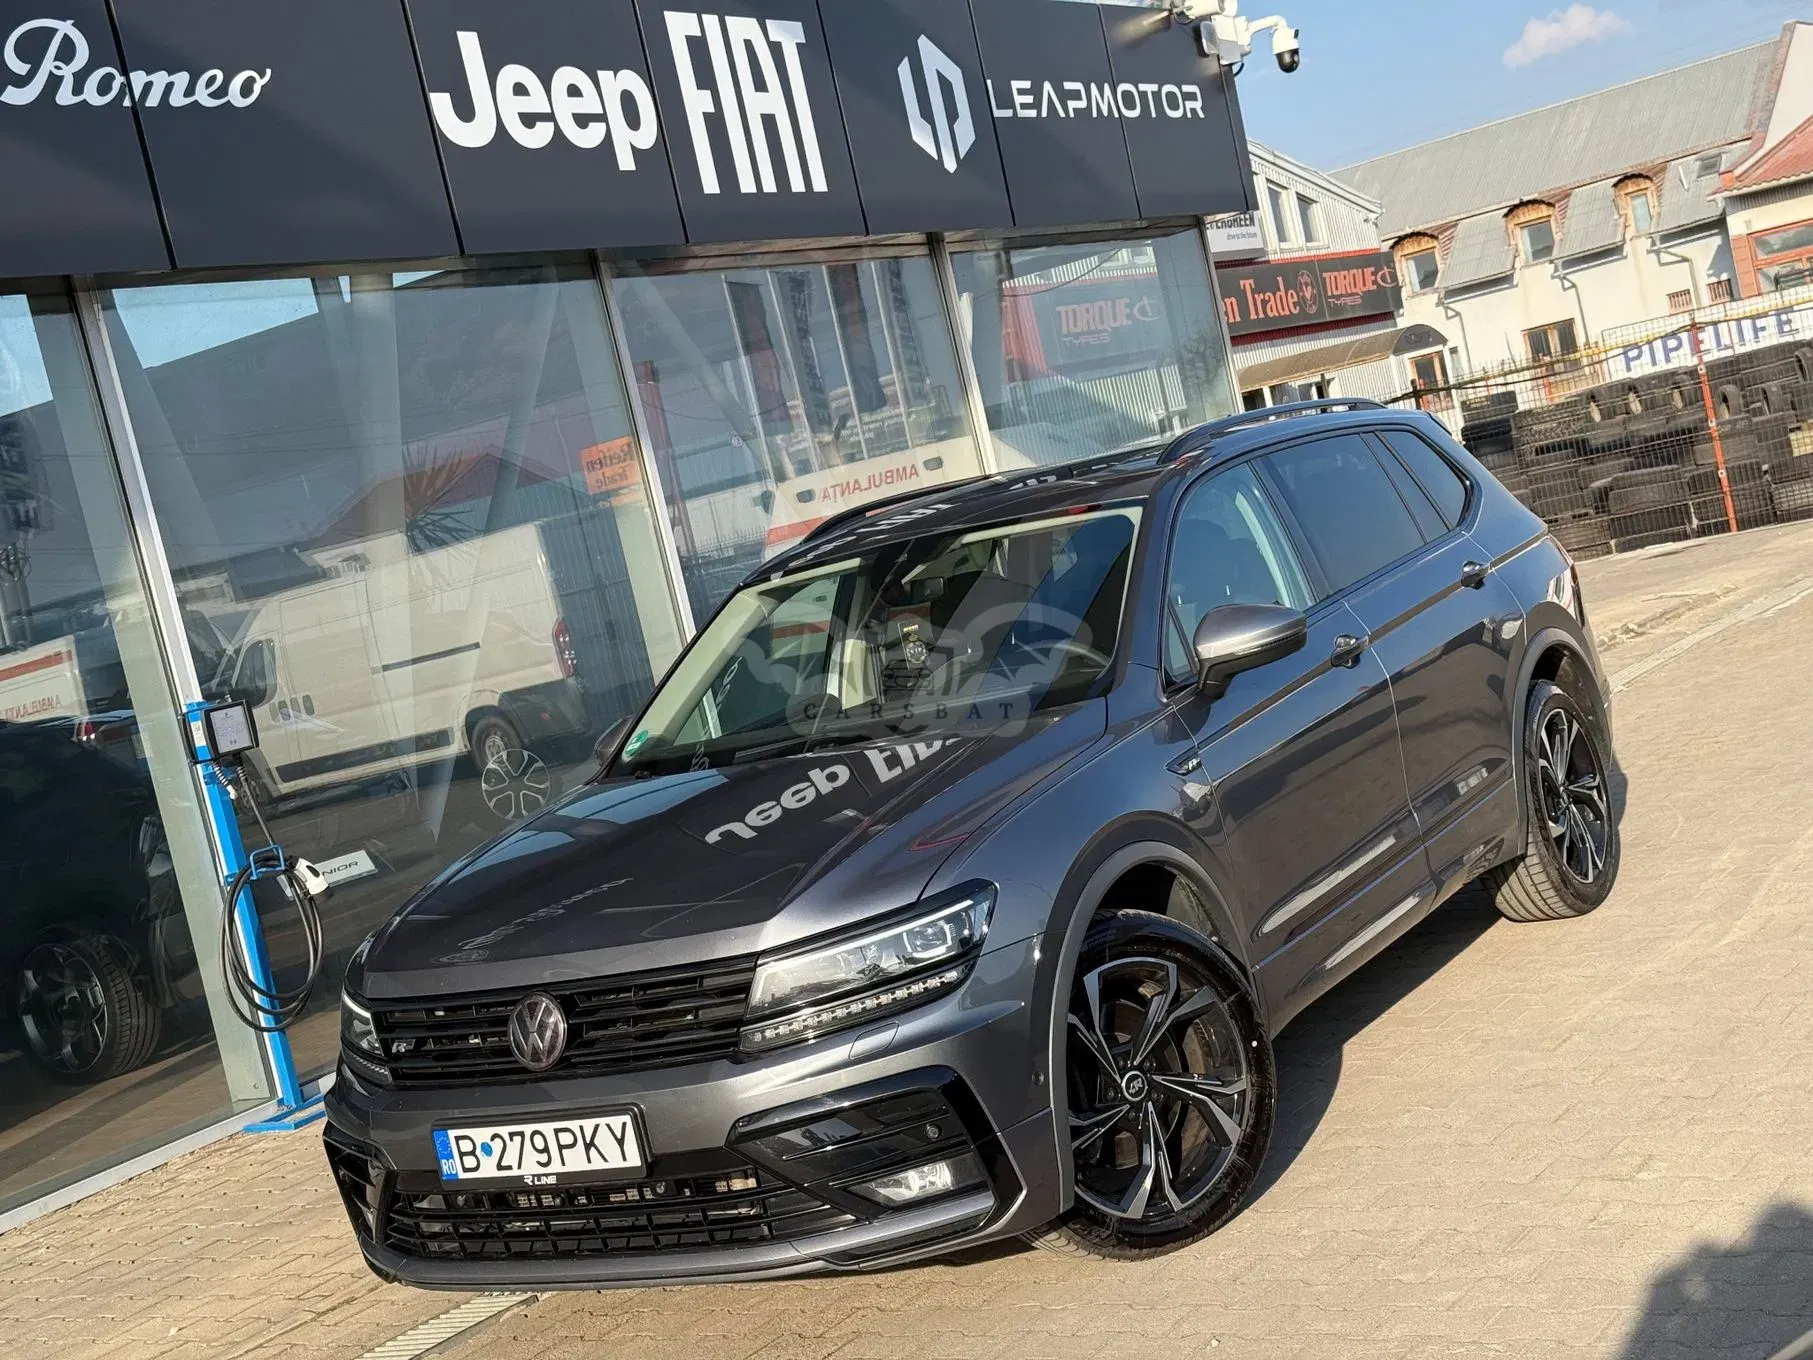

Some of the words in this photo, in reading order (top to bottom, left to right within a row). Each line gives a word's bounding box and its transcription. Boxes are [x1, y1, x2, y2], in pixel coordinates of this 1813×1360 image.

[0, 18, 271, 108] Romeo
[429, 31, 658, 171] Jeep
[664, 11, 828, 194] FIAT
[986, 79, 1205, 119] LEAPMOTOR
[1240, 276, 1300, 320] Trade
[1323, 267, 1377, 296] TORQUE
[1056, 298, 1132, 335] TORQUE
[441, 1158, 457, 1175] RO
